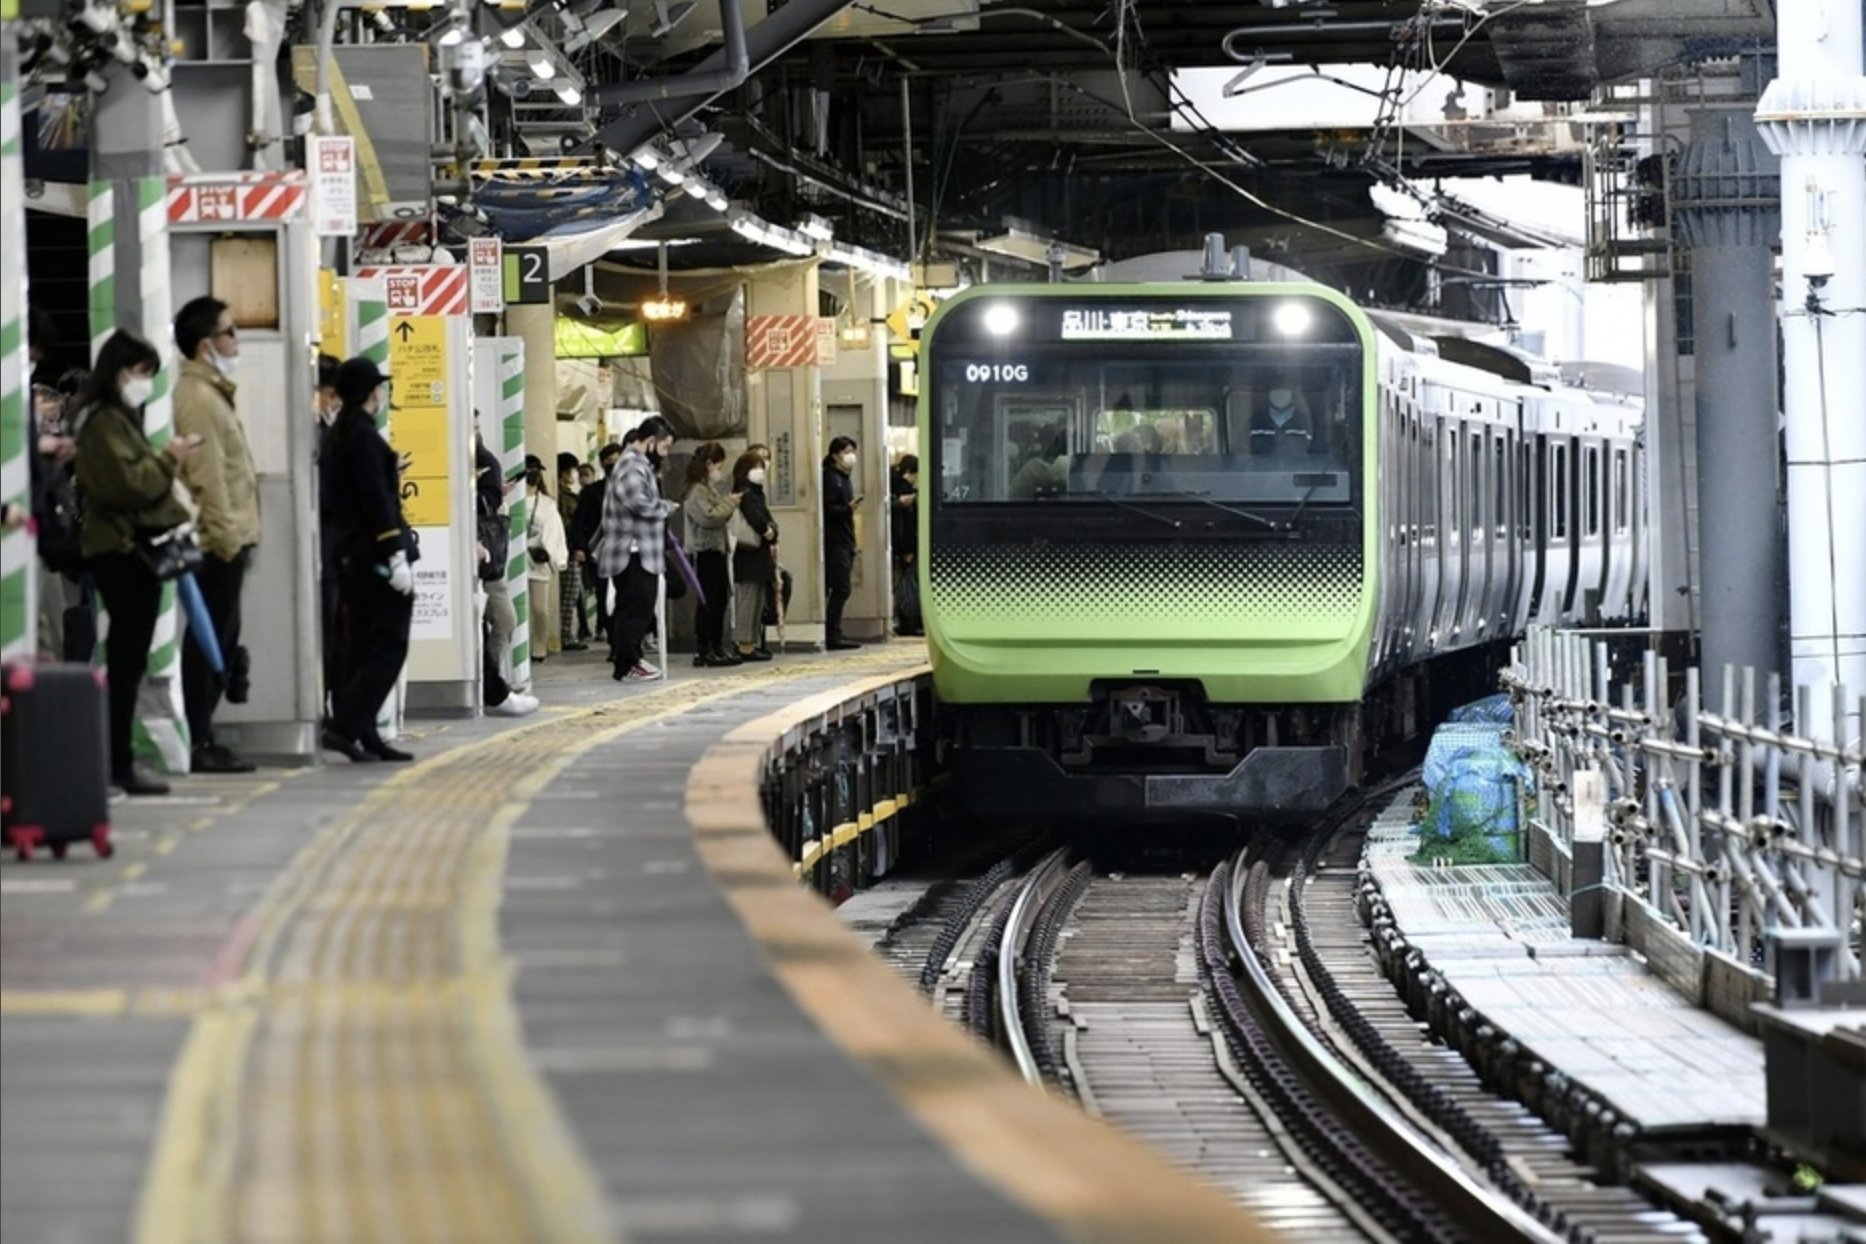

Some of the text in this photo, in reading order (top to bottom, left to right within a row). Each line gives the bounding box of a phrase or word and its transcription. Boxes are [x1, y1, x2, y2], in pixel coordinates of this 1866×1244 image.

[523, 254, 543, 283] 2
[389, 279, 417, 288] STOP
[966, 364, 1028, 382] 0910G
